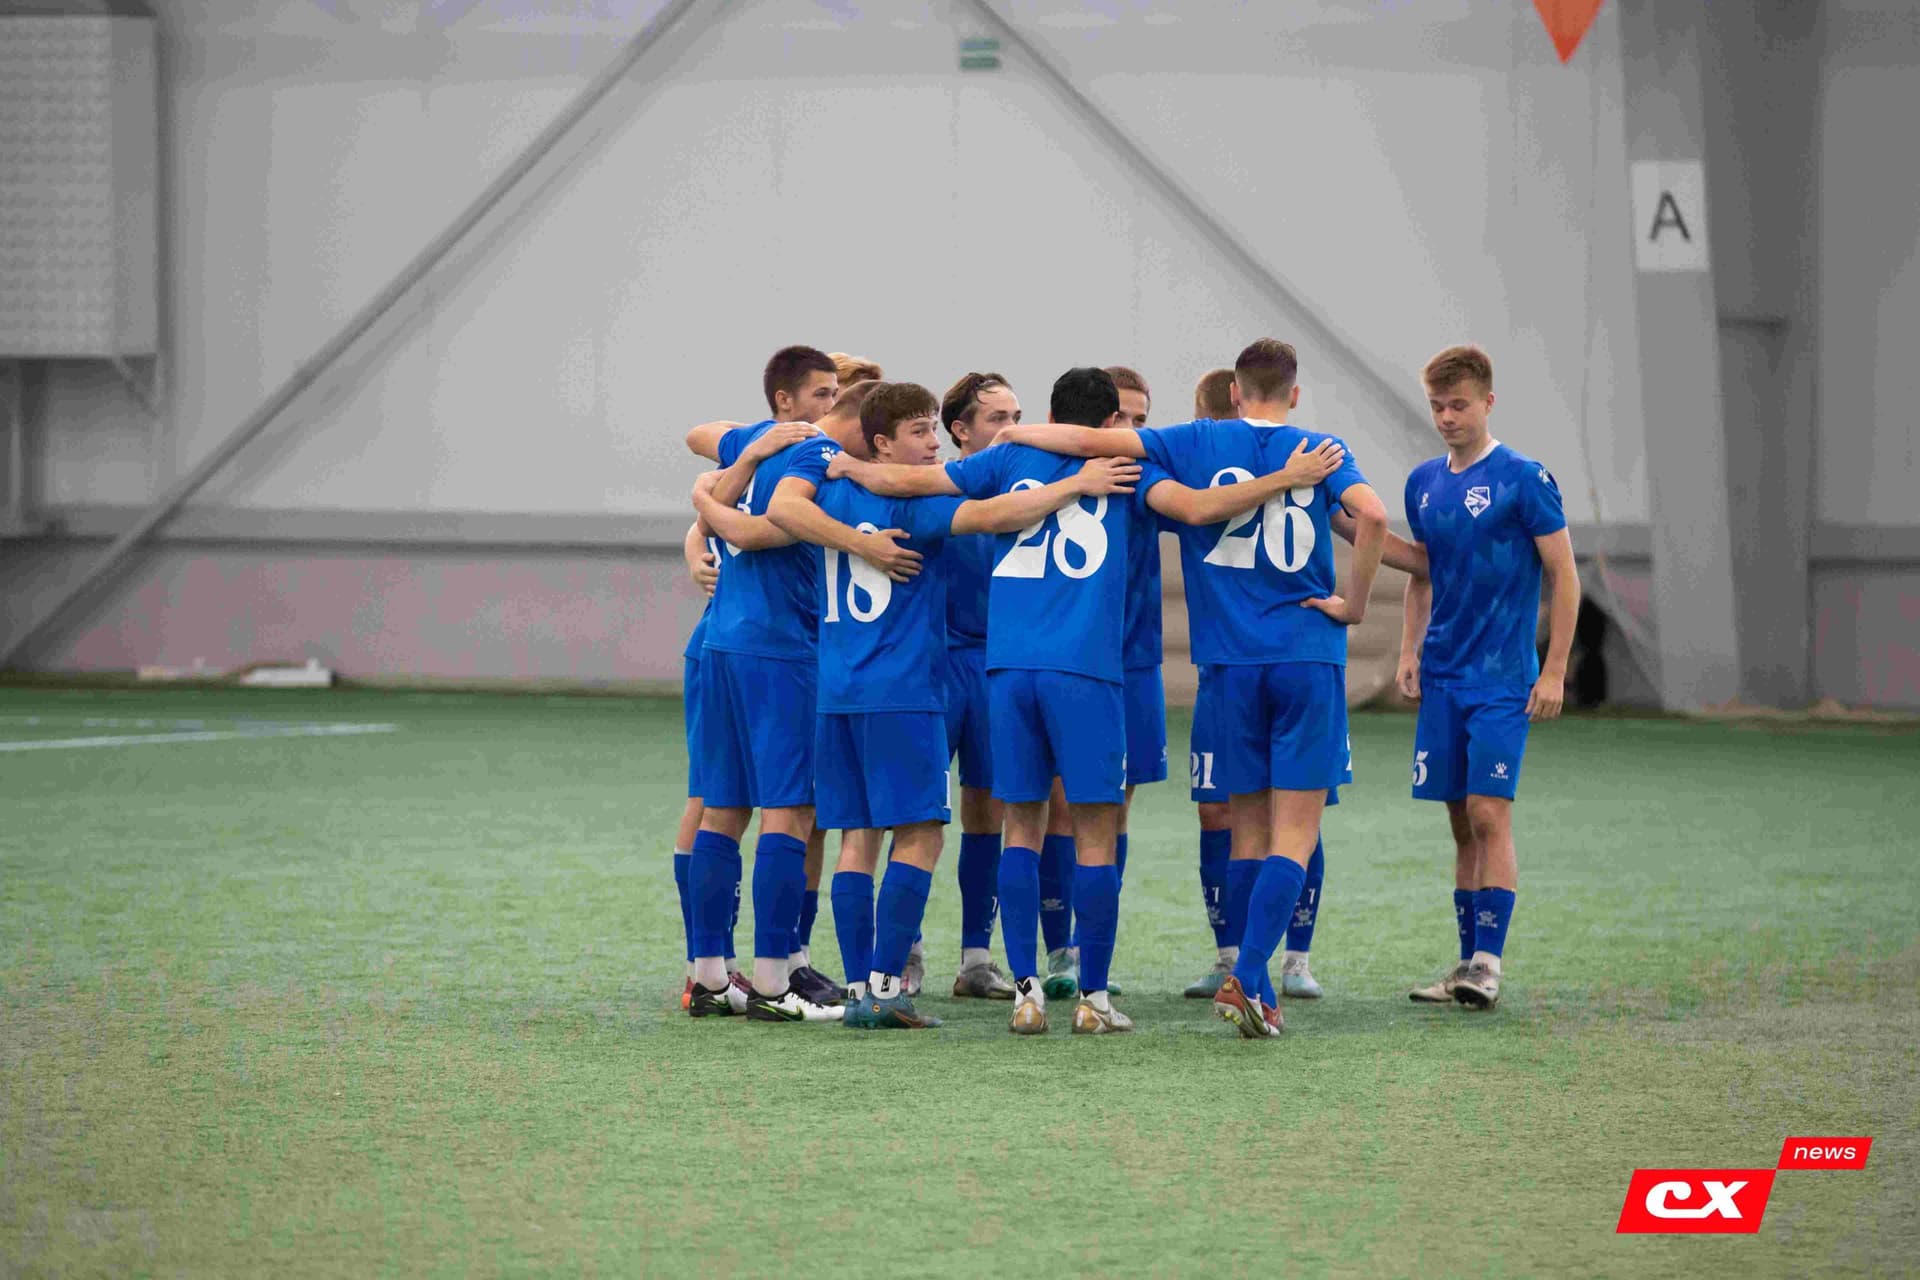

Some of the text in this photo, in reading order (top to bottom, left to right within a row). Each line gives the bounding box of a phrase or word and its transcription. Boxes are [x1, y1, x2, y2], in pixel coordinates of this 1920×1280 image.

[1648, 190, 1690, 242] A
[992, 478, 1108, 579] 28
[1203, 467, 1315, 573] 26
[825, 522, 892, 622] 18
[1191, 751, 1216, 789] 21
